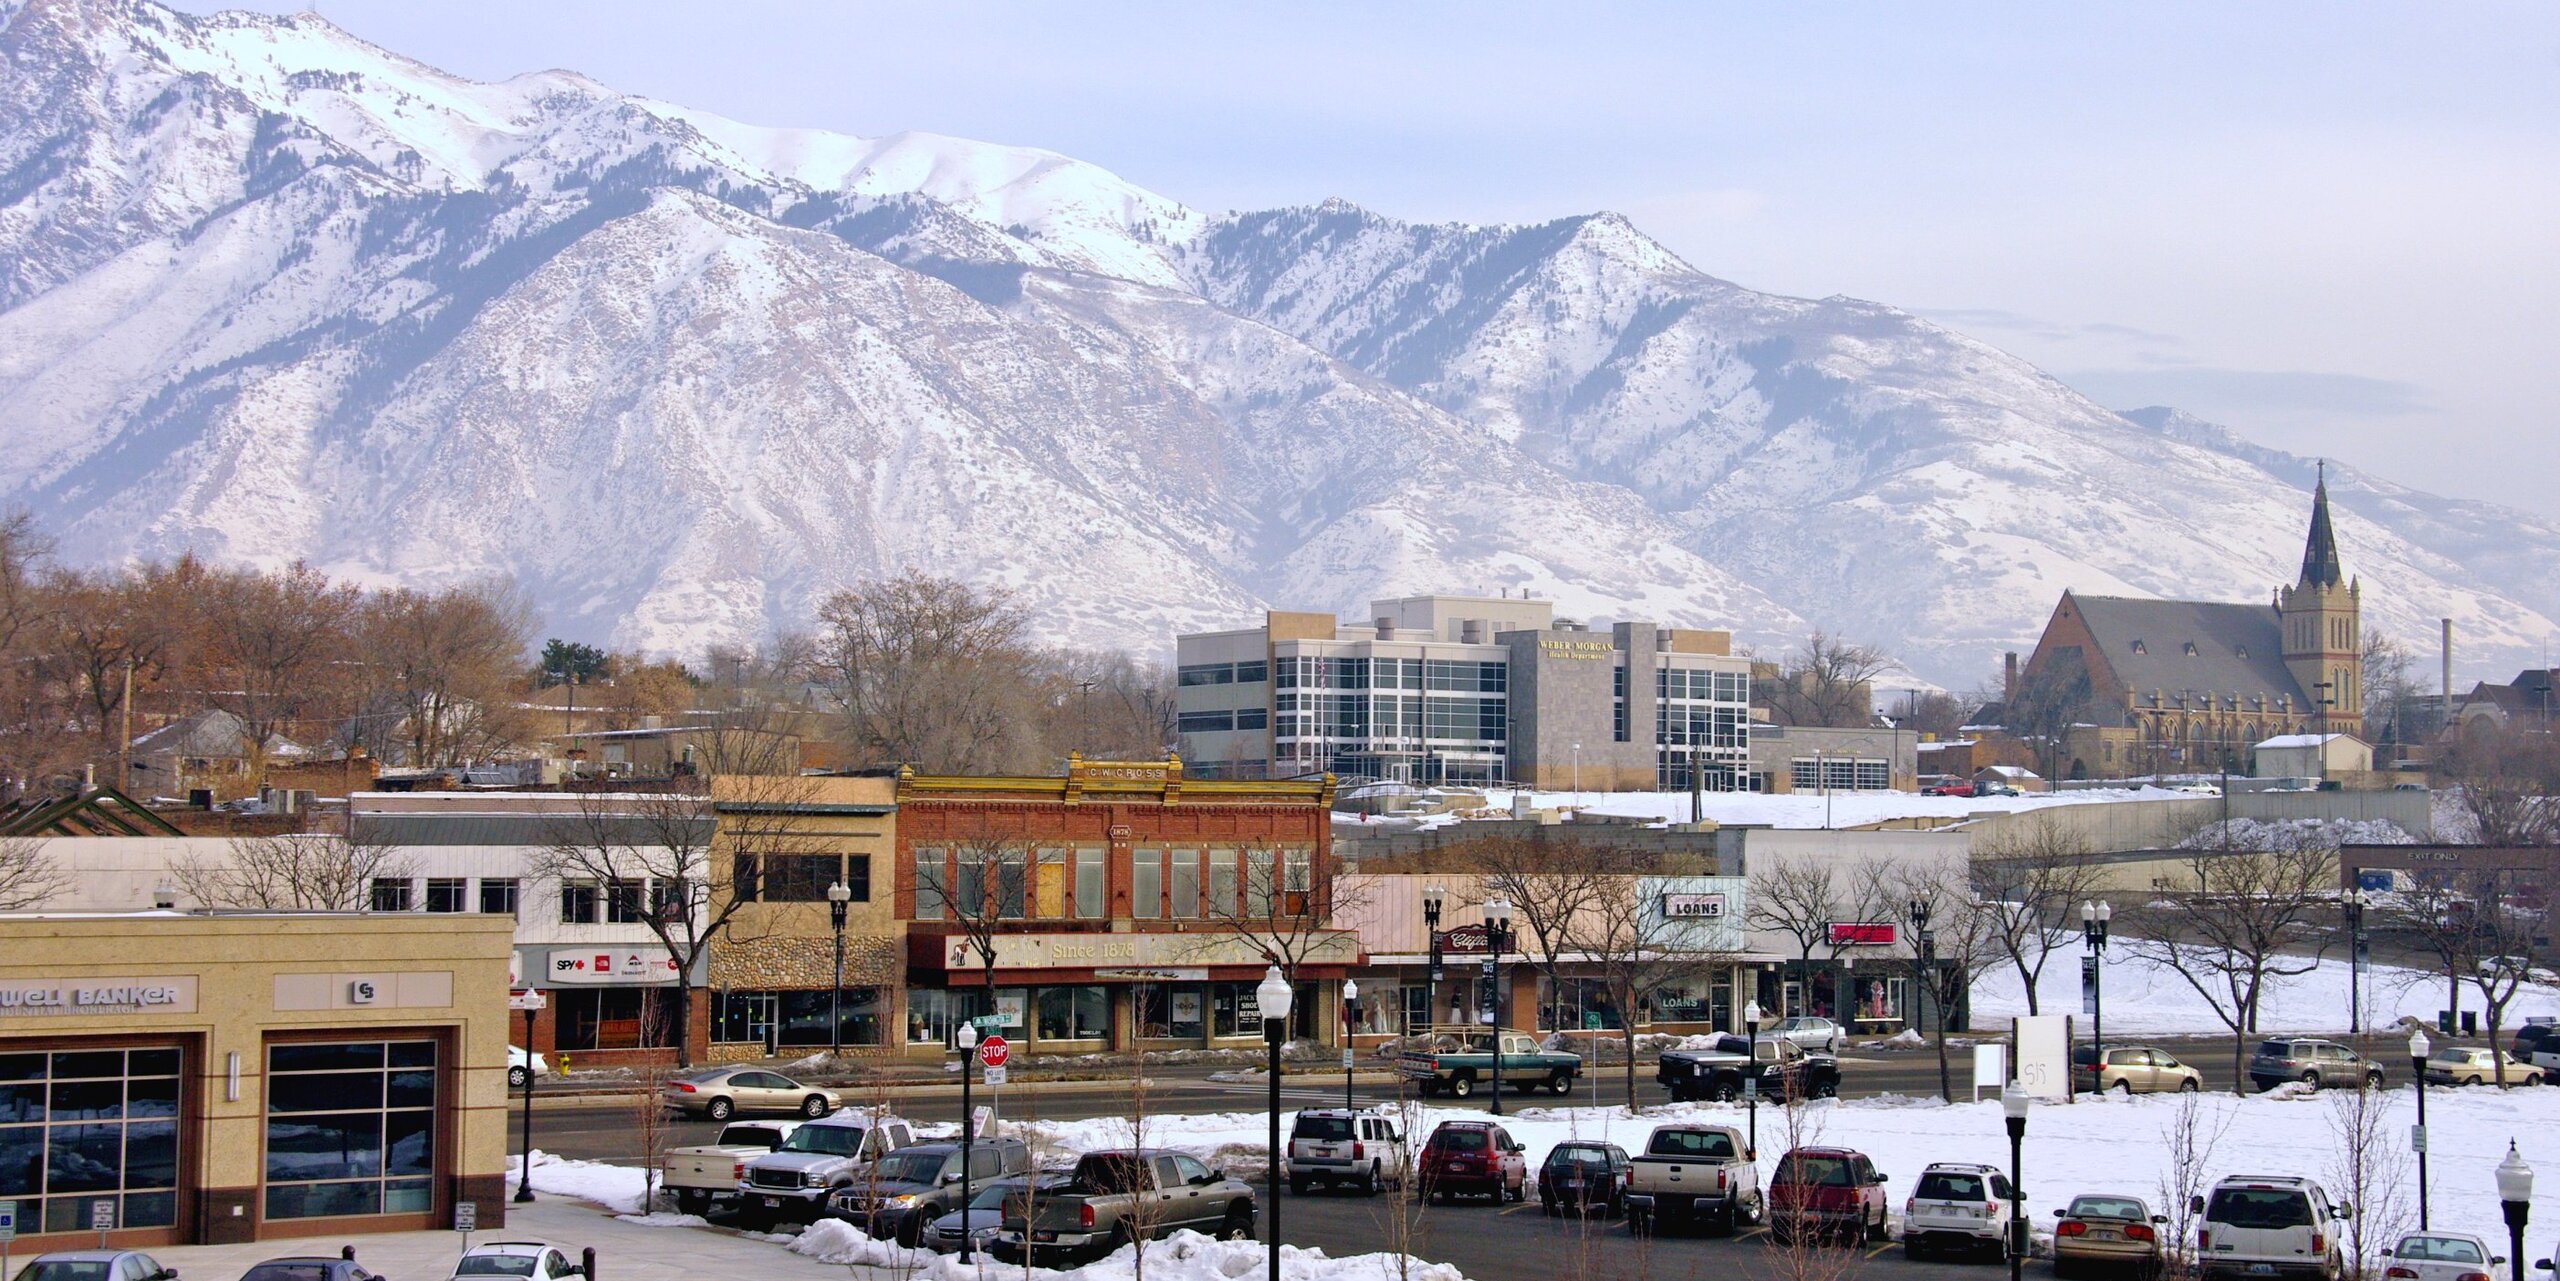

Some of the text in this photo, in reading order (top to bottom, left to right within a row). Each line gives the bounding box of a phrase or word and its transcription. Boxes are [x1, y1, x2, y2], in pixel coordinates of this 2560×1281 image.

[1090, 768, 1162, 778] C W CROSS
[2407, 852, 2459, 861] EXIT ONLY
[1676, 903, 1718, 915] LOANS
[1053, 942, 1135, 959] Since 1878
[556, 960, 576, 971] SPY
[76, 986, 180, 1008] BANKER
[1662, 998, 1699, 1009] LOANS
[982, 1045, 1007, 1058] STOP
